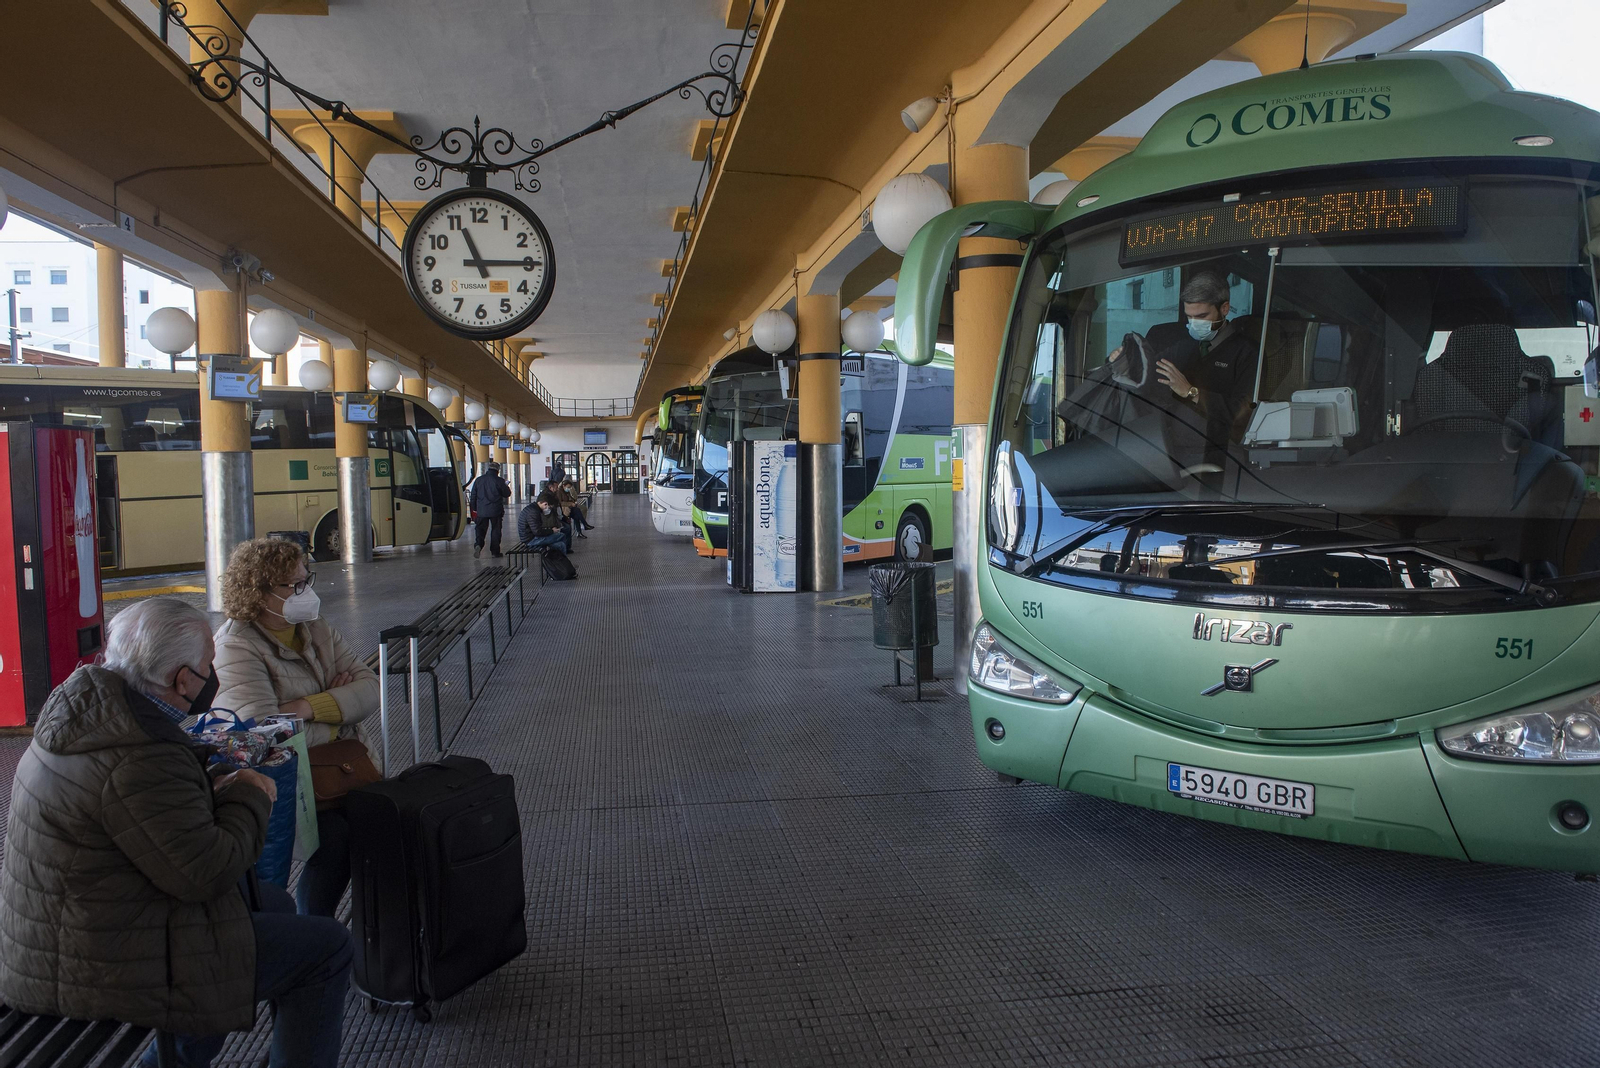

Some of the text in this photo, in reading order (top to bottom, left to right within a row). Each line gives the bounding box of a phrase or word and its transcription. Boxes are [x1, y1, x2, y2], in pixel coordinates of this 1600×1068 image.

[1271, 85, 1392, 105] TRANSPORTES GENERALES
[1231, 94, 1391, 136] COMES
[447, 215, 462, 231] 11
[469, 207, 489, 223] 12
[500, 215, 509, 231] 1
[124, 216, 131, 231] 4
[1251, 208, 1413, 239] (AUTOPISTA)
[428, 234, 449, 250] 10
[516, 232, 528, 248] 2
[423, 255, 436, 272] 9
[523, 256, 535, 272] 3
[431, 278, 443, 295] 8
[516, 279, 529, 295] 4
[453, 297, 464, 313] 7
[474, 304, 487, 320] 6
[499, 298, 512, 314] 5
[83, 388, 161, 398] www.tgcomes.es
[756, 456, 774, 529] aquaBona
[1022, 600, 1044, 620] 551
[1495, 637, 1534, 660] 551
[1184, 770, 1307, 809] 5940 GBR
